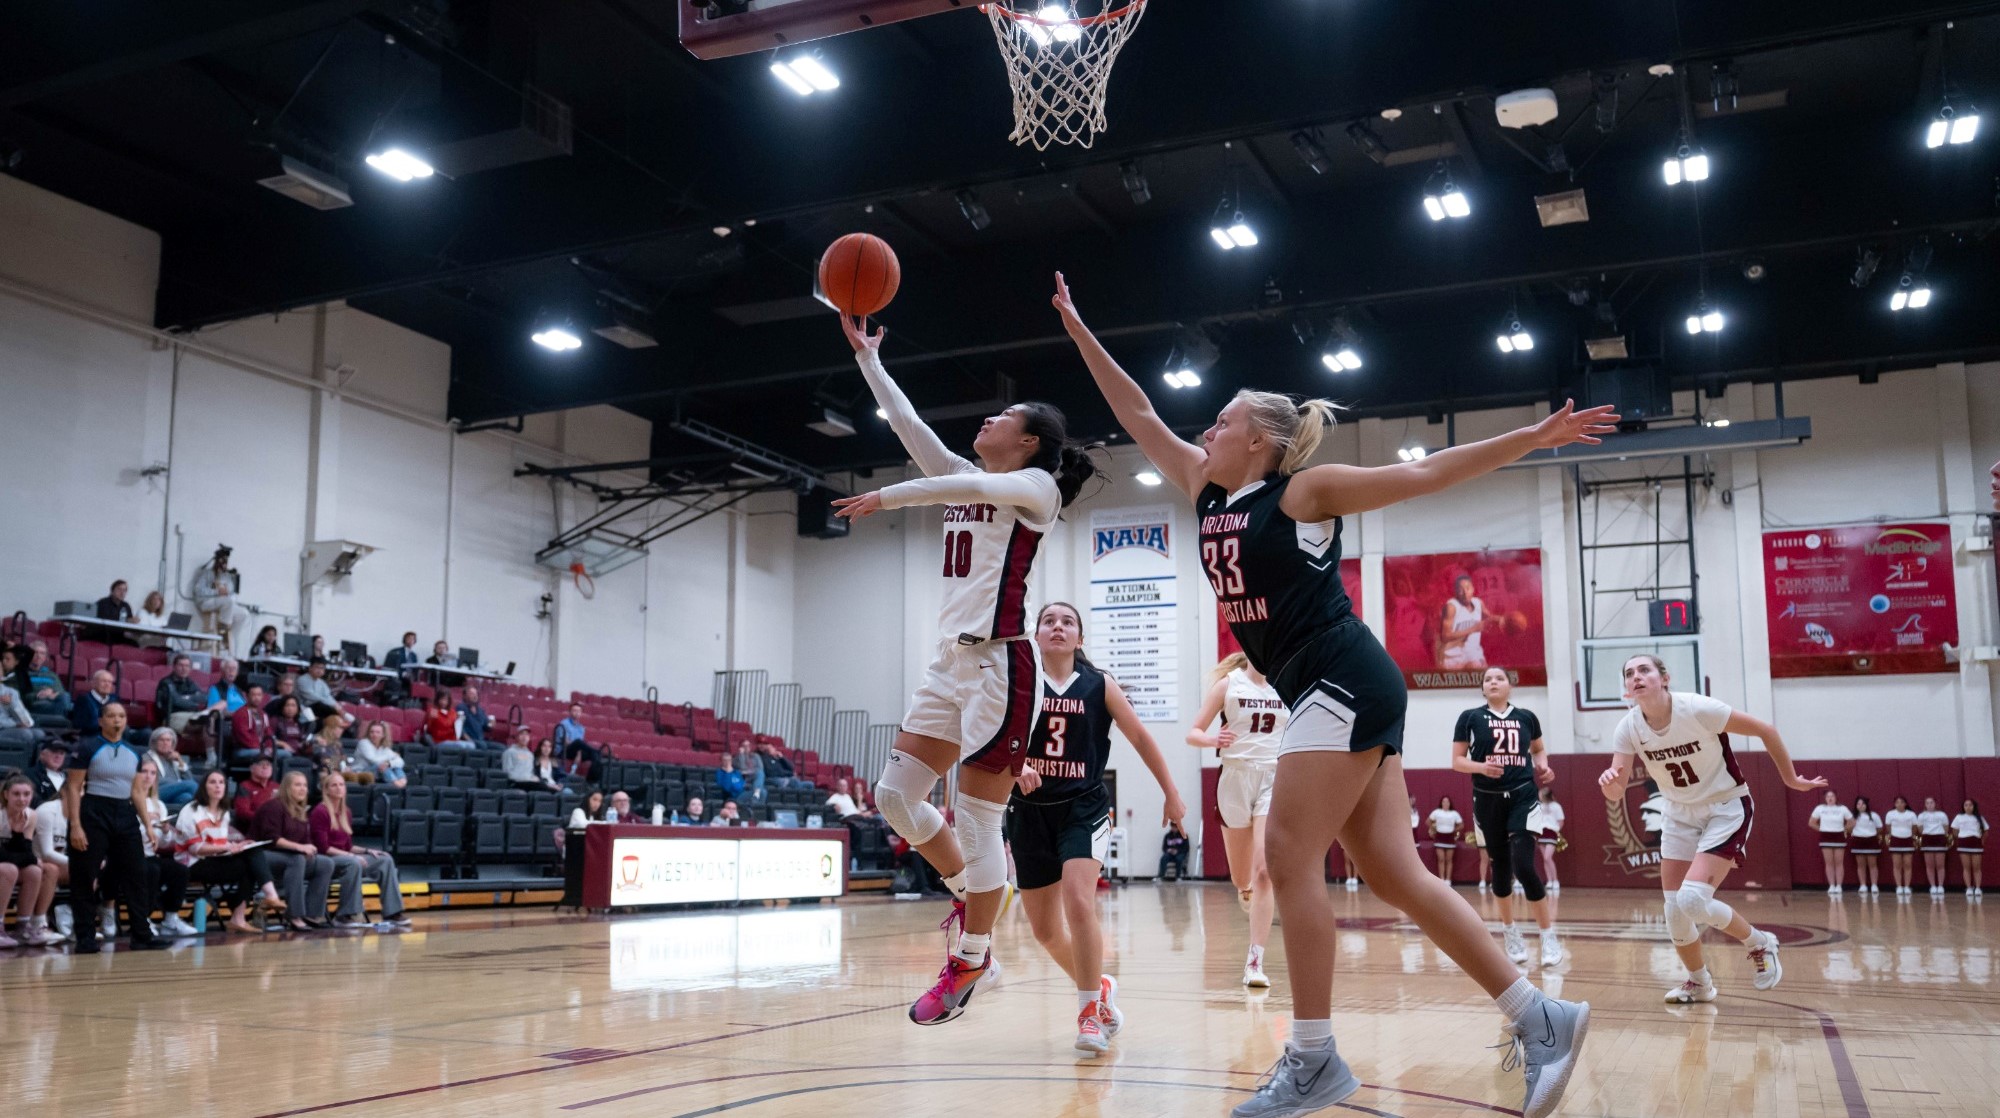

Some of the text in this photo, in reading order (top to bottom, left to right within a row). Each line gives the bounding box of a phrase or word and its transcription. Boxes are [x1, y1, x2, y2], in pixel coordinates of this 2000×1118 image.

[944, 503, 998, 523] ESTMONT
[1201, 512, 1250, 535] ARIZONA
[1096, 527, 1166, 557] NAIA
[943, 530, 973, 578] 10
[1203, 537, 1245, 597] 33
[1106, 593, 1161, 603] CHAMPION
[1108, 584, 1159, 594] NATIONAL
[1220, 597, 1268, 622] RISTIAN
[1664, 601, 1687, 627] 17
[1413, 671, 1519, 688] WARRIS
[1042, 697, 1086, 714] RIZONA
[1249, 712, 1276, 734] 13
[1488, 719, 1521, 729] ARIZONA
[1045, 715, 1067, 758] 3
[1493, 728, 1520, 754] 20
[1643, 740, 1702, 762] WESTMONT
[1664, 760, 1701, 788] 21
[651, 861, 736, 882] WESTMONT
